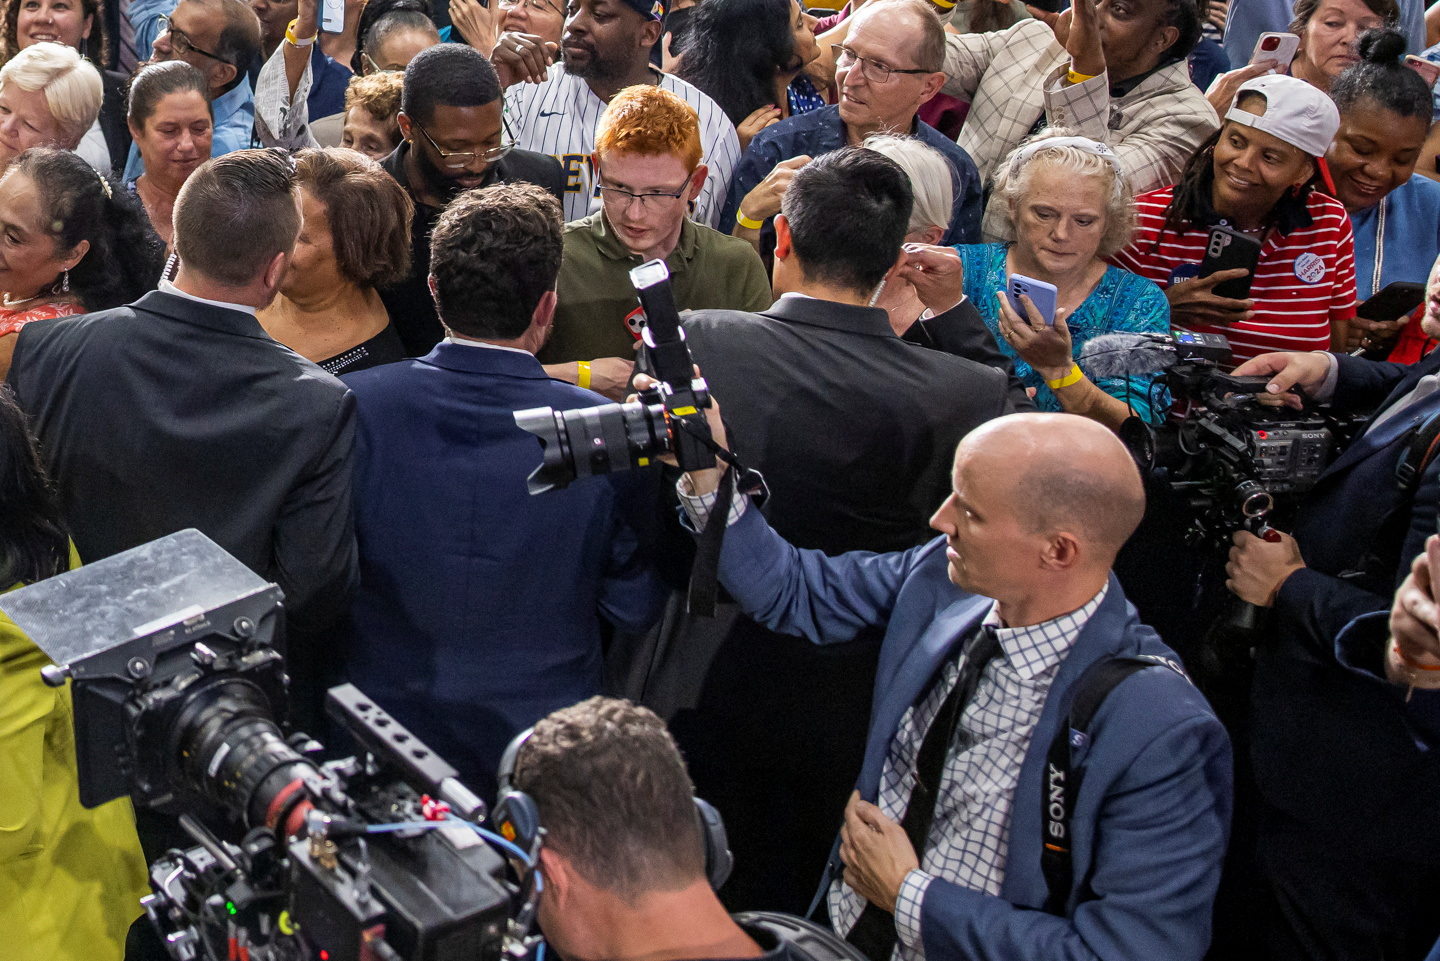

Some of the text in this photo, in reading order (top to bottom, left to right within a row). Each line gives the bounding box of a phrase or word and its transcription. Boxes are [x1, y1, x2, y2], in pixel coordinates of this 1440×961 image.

[1298, 257, 1320, 278] HARRIS
[1306, 264, 1324, 281] 2024
[1049, 762, 1066, 839] SONY
